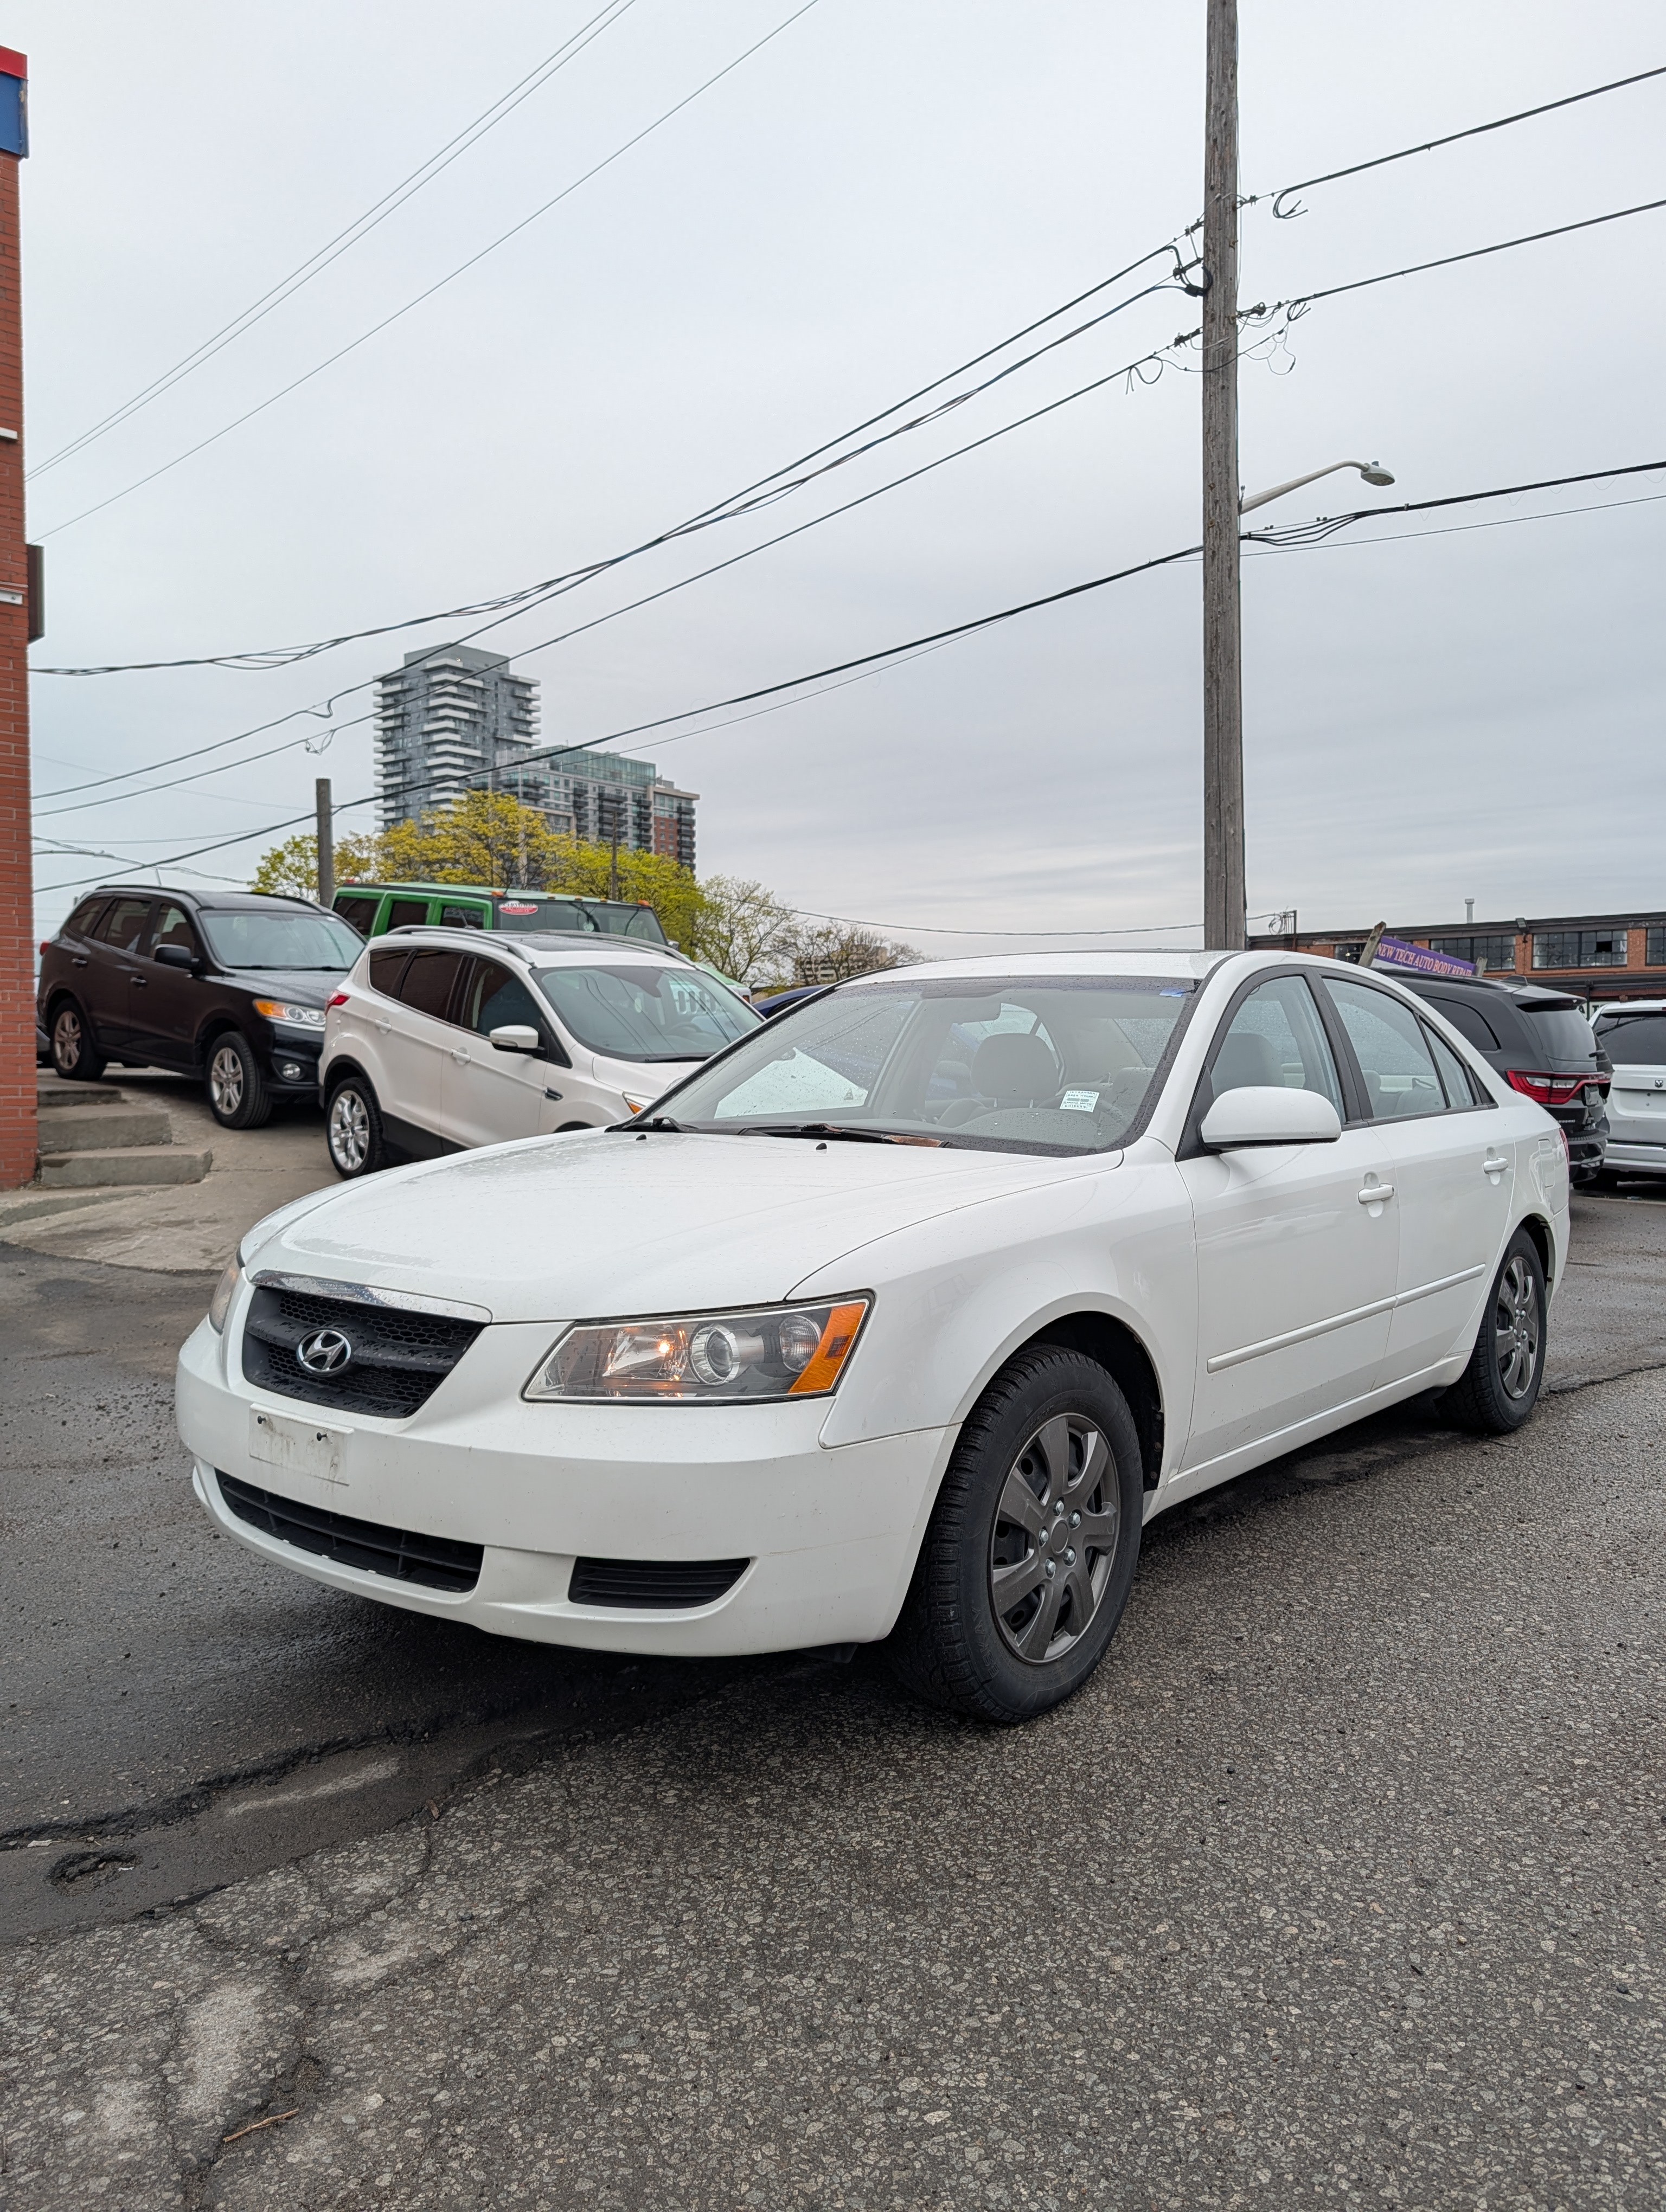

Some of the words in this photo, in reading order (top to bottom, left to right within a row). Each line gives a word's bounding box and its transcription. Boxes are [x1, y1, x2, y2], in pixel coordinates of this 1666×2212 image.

[1375, 943, 1395, 959] NEW
[1394, 948, 1416, 964] TECH
[1413, 955, 1434, 970] AUTO
[1432, 959, 1453, 974] BODY
[1451, 965, 1472, 976] REPAIR
